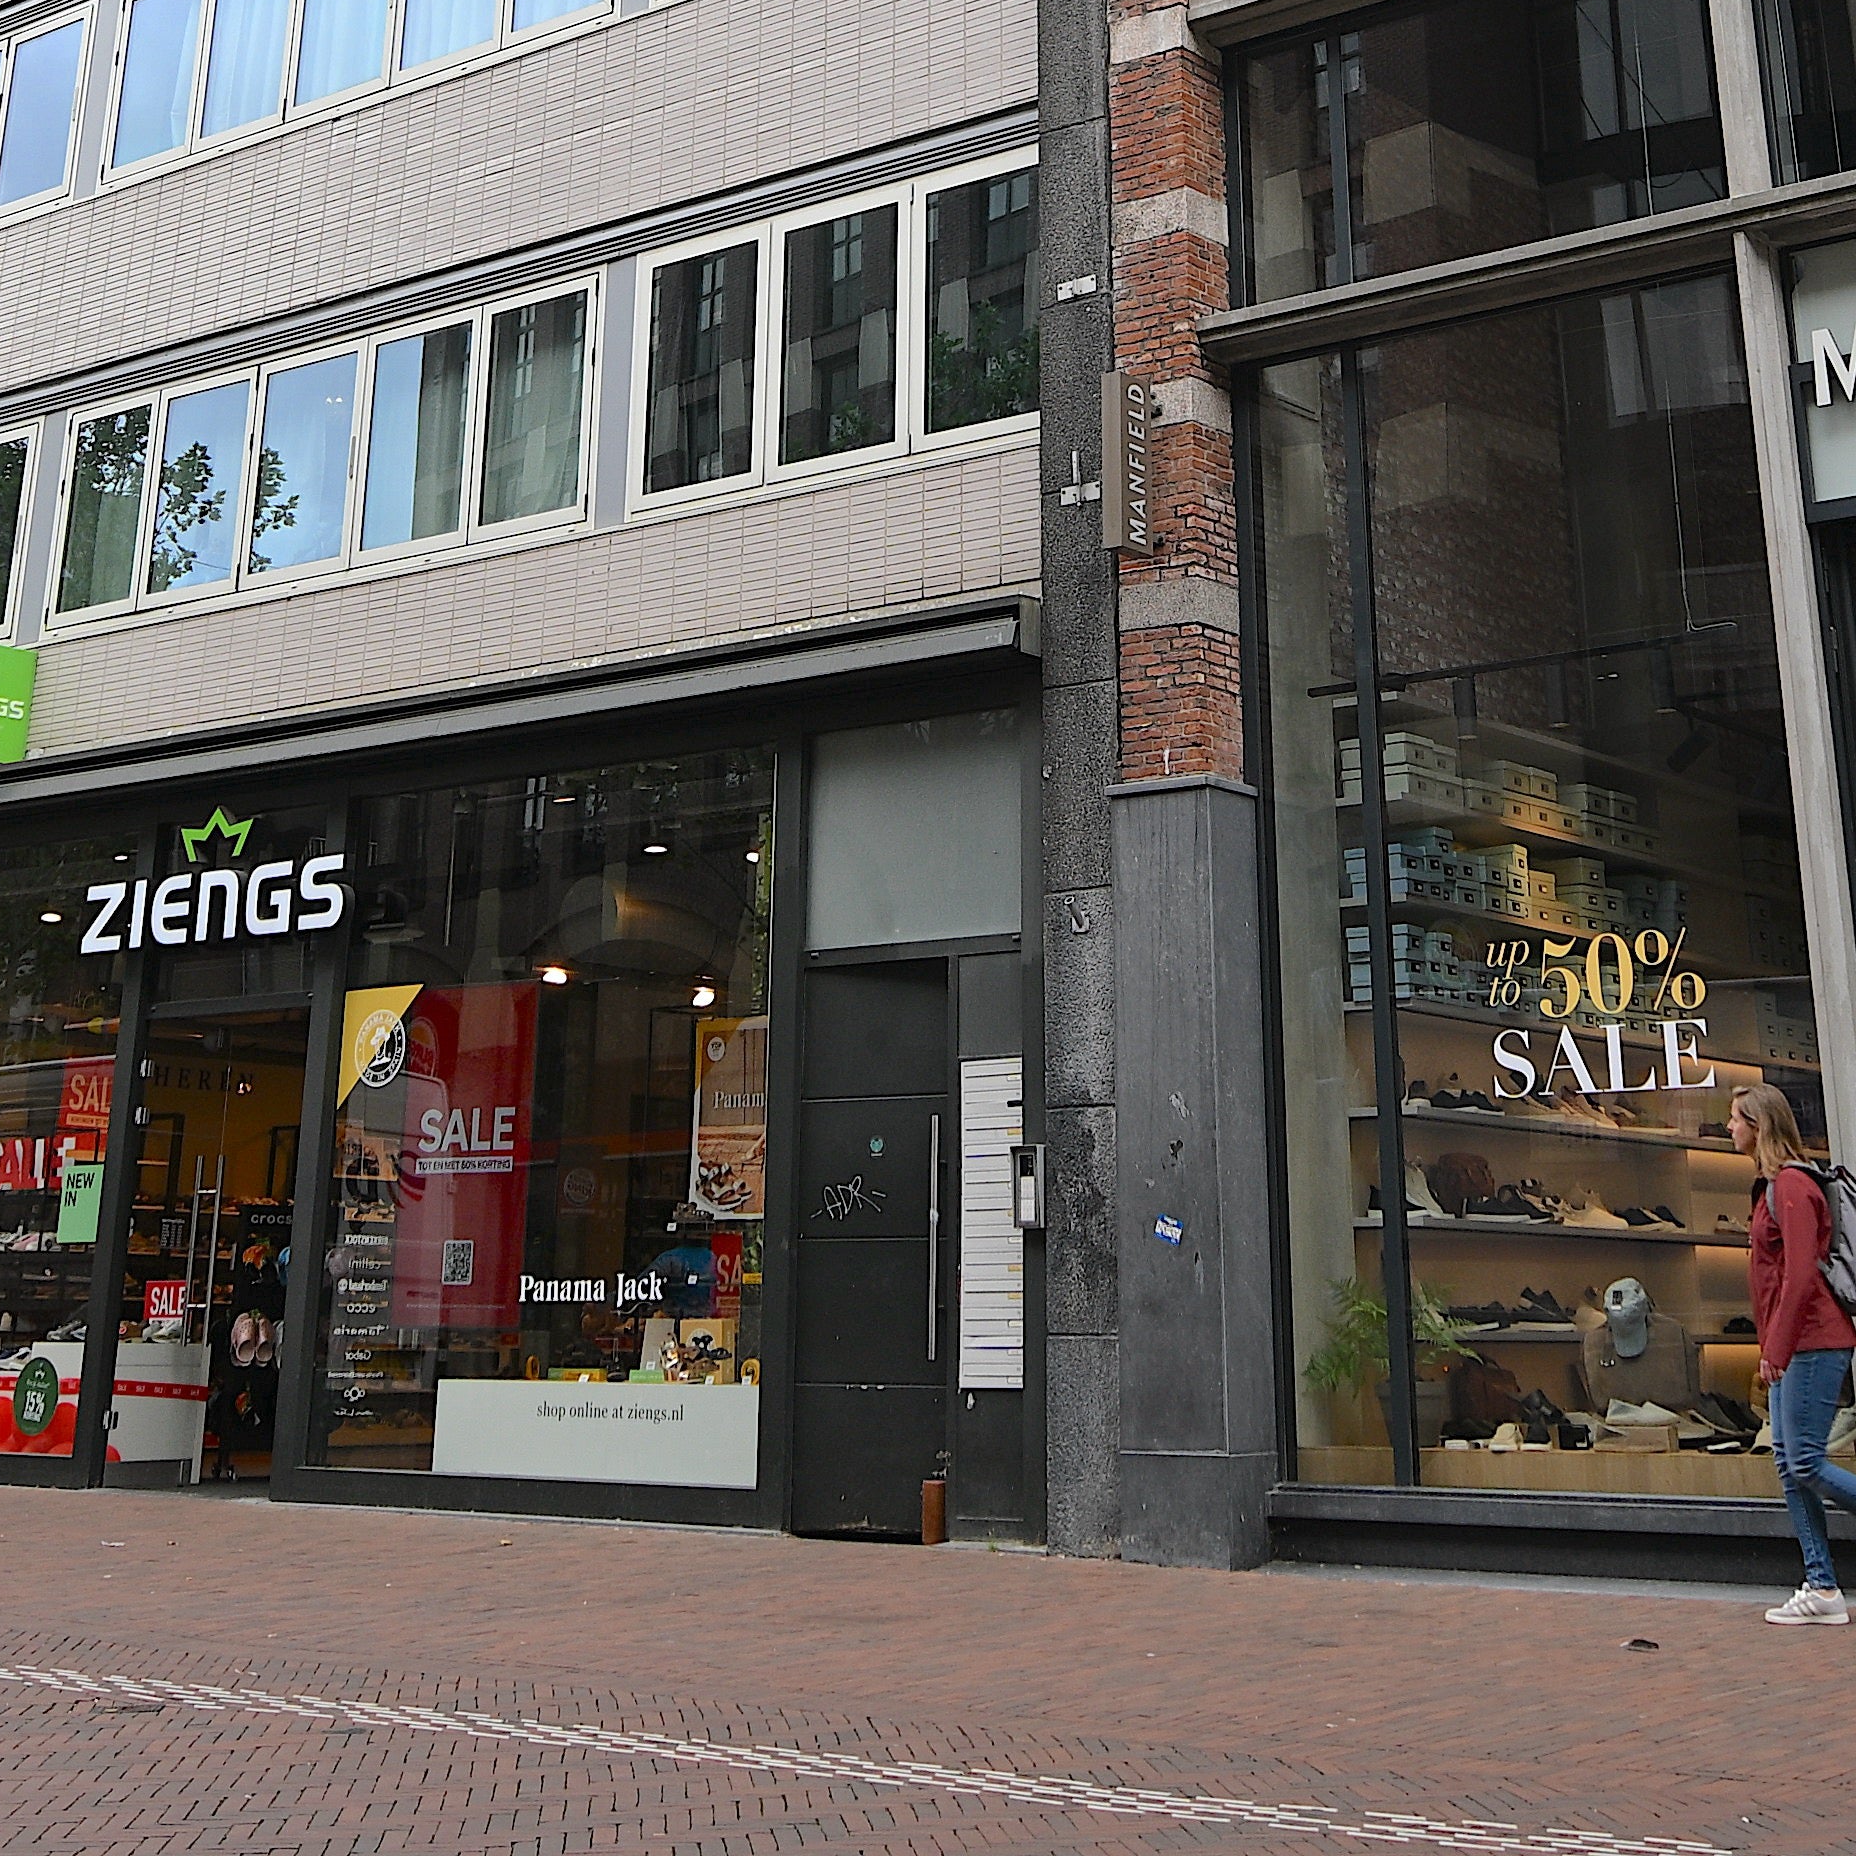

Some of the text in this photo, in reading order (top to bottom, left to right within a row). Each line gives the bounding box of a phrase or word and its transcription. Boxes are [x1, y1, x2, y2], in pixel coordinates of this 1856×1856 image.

[1127, 384, 1147, 545] MANFIELD
[80, 853, 344, 954] ZIENGS
[1486, 939, 1530, 981] up
[1539, 927, 1707, 1018] 50%
[1490, 976, 1521, 1007] to
[1493, 1018, 1716, 1098] SALE
[419, 1107, 515, 1153] SALE
[64, 1191, 77, 1206] IN
[66, 1173, 95, 1189] NEW
[150, 1286, 186, 1315] SALE
[519, 1271, 664, 1307] Panama Jack
[25, 1391, 45, 1415] 15%
[536, 1401, 684, 1423] shop online at ziengs.nl
